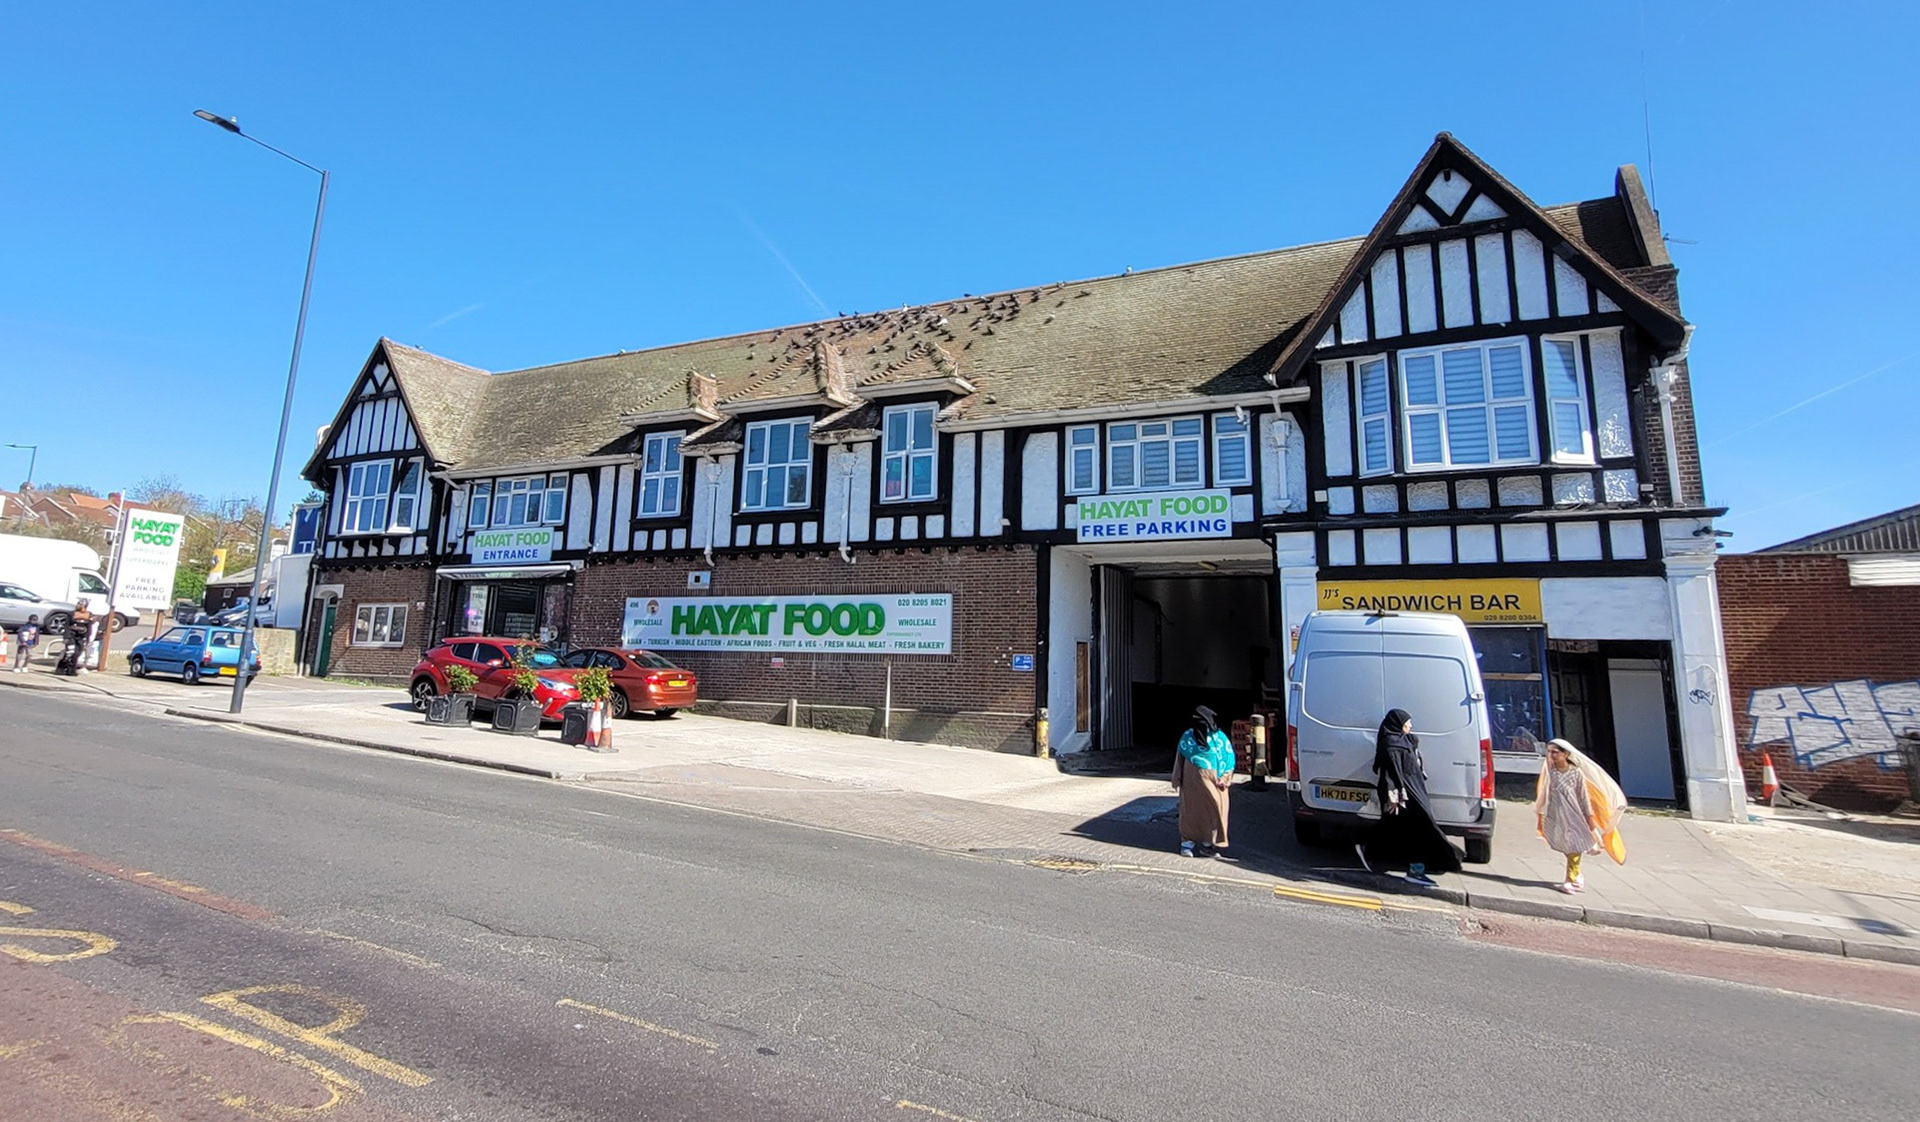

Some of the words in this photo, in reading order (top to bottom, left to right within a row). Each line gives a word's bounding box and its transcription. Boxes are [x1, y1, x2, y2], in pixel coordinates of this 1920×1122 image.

[1080, 499, 1153, 520] HAYAT
[1160, 495, 1228, 516] FOOD
[131, 517, 181, 534] HAYAT
[1081, 523, 1129, 537] FREE
[1136, 519, 1226, 534] PARKING
[133, 531, 174, 547] FOOD
[475, 533, 513, 548] HAYAT
[515, 531, 551, 547] FOOD
[483, 549, 538, 560] ENTRANCE
[135, 576, 157, 584] FREE
[125, 584, 165, 593] PARKING
[119, 592, 166, 602] AVAILABLE
[898, 598, 910, 606] 020
[912, 598, 928, 606] 8205
[930, 598, 947, 606] 8021
[1342, 595, 1461, 610] SANDWICH
[1470, 594, 1521, 610] BAR
[671, 604, 778, 636] HAYAT
[783, 603, 885, 636] FOOD
[898, 619, 937, 627] WHOLESALE
[894, 641, 916, 649] FRESH
[1321, 788, 1347, 801] HK70
